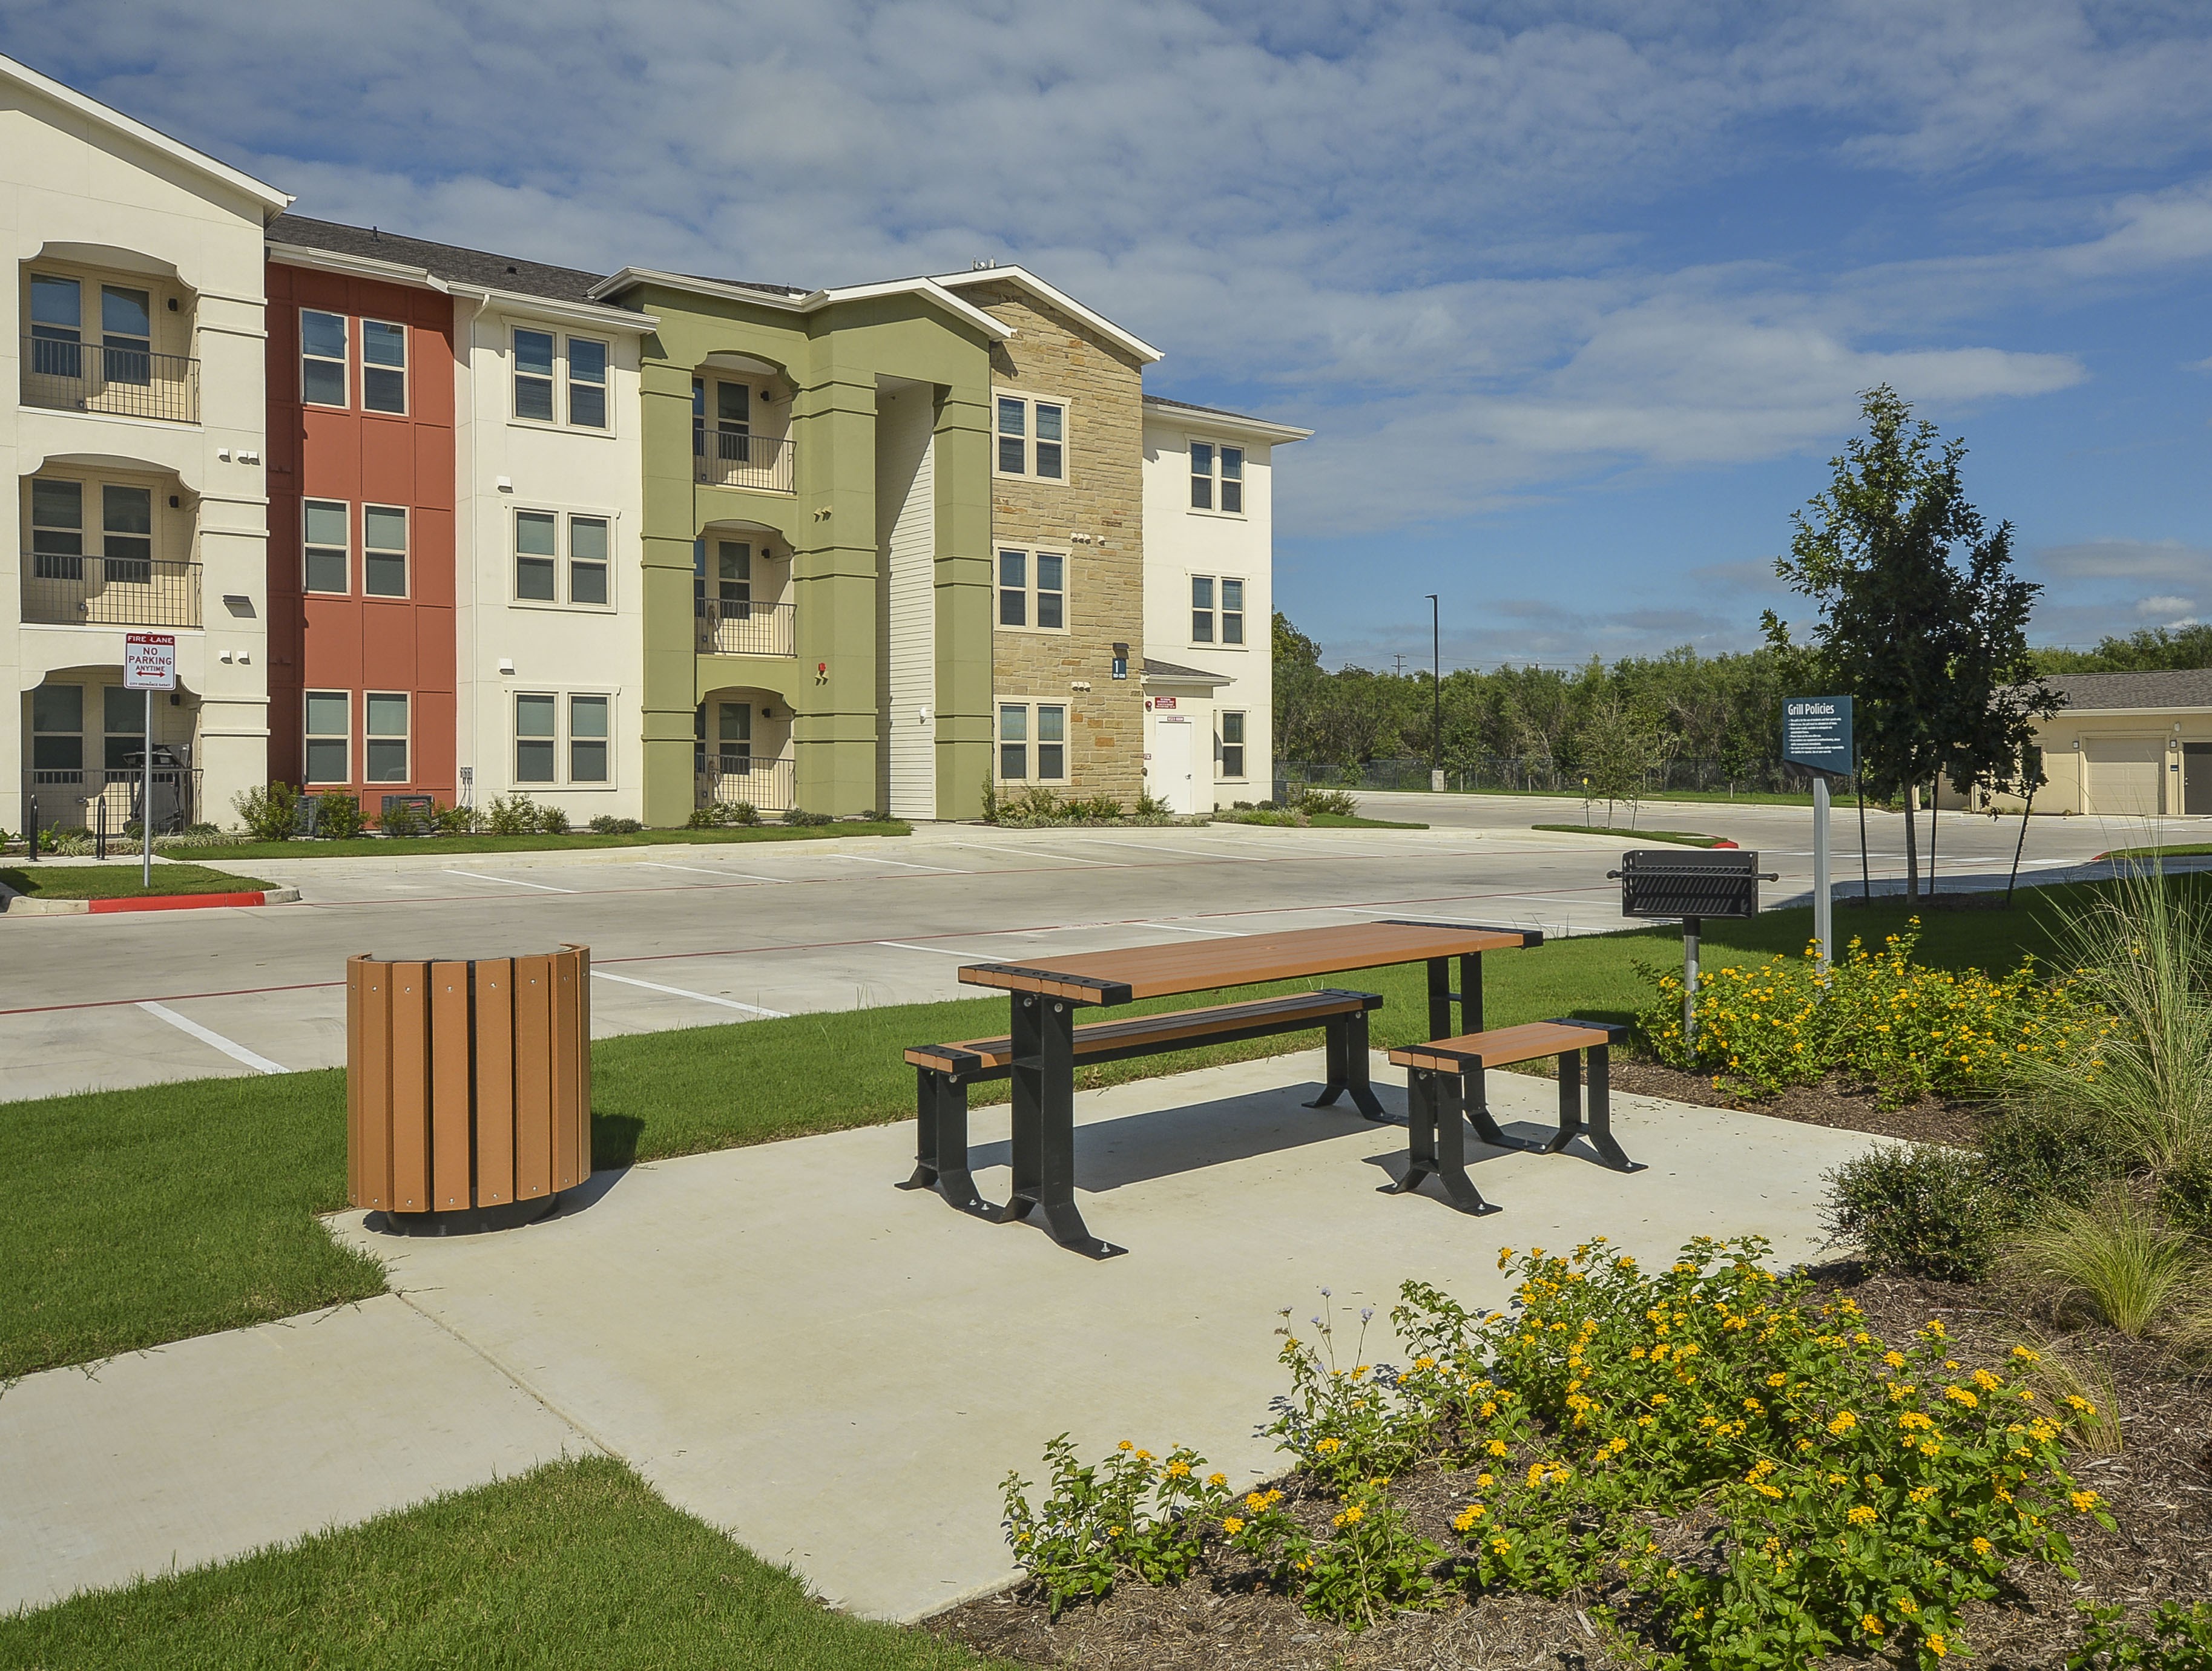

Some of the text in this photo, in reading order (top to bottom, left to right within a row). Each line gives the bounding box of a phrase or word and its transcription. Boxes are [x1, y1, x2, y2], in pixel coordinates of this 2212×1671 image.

[143, 647, 158, 655] NO
[128, 655, 172, 665] PARKING
[1114, 660, 1119, 673] 1
[1788, 703, 1835, 715] Grill Policies
